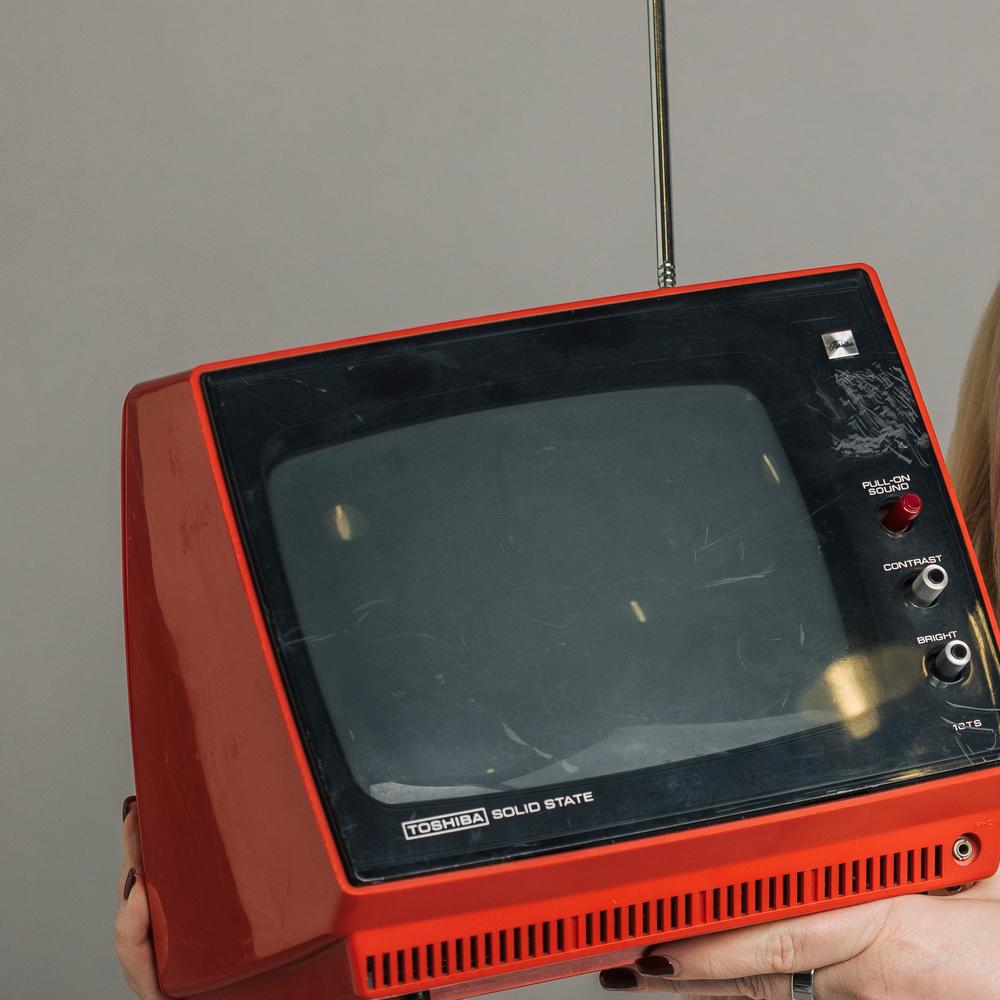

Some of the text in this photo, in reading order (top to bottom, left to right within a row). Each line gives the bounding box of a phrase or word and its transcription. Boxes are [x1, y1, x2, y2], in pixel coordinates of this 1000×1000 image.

[862, 474, 911, 489] PULL-ON
[868, 482, 910, 496] SOUND
[883, 555, 942, 571] CONTRAST
[917, 631, 958, 644] BRIGHT
[407, 791, 594, 836] TOSHIBA SOLID STATE
